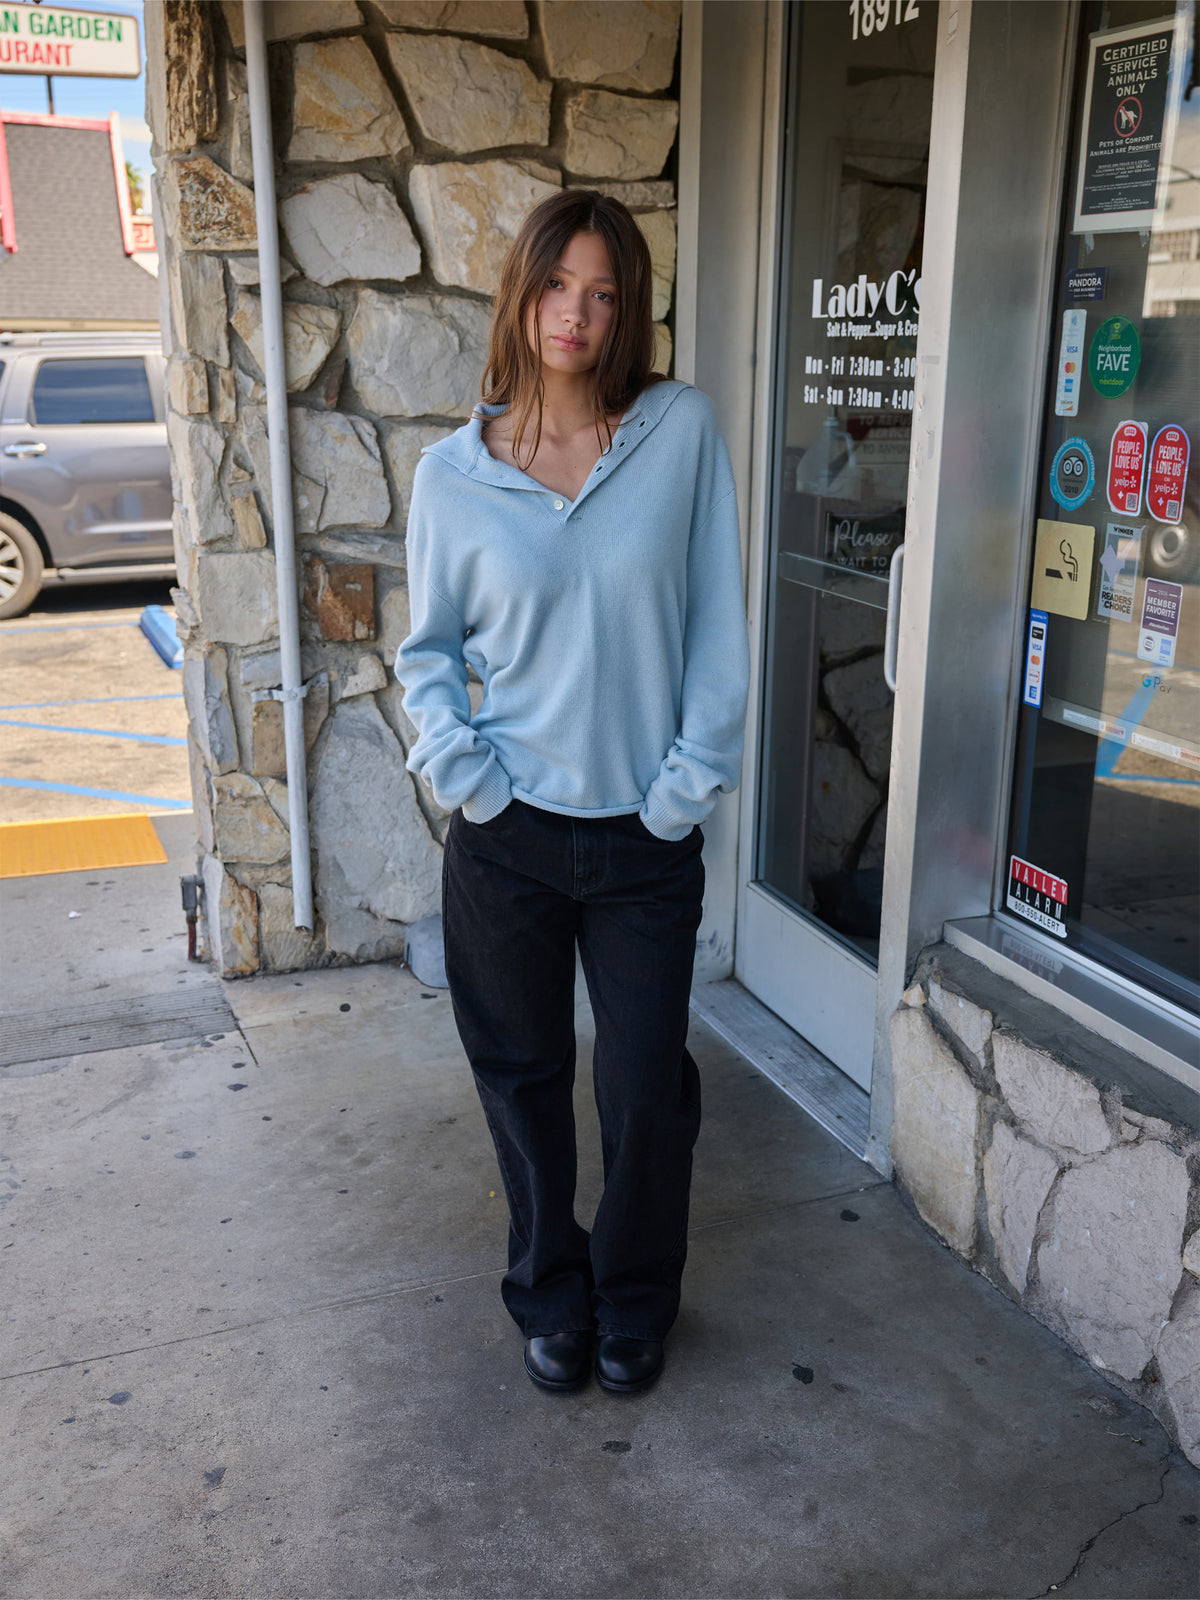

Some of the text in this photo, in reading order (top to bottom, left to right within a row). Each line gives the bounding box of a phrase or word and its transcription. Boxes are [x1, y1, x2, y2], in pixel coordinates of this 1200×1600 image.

[29, 12, 122, 42] GARDEN
[1103, 38, 1168, 62] CERTIFIED
[1110, 56, 1157, 74] SERVICE
[1107, 68, 1158, 87] ANIMALS
[1116, 83, 1146, 97] ONLY
[1125, 135, 1154, 144] COMFORT
[1089, 149, 1114, 157] ANIMALS
[1069, 277, 1102, 288] PANDORA
[827, 321, 840, 337] Salt
[841, 322, 847, 337] &
[897, 320, 903, 336] &
[1098, 345, 1132, 353] Neighborhood
[805, 356, 822, 374] Mon
[831, 356, 844, 375] Fri
[850, 356, 883, 376] 7:30am
[894, 357, 916, 377] 3:00
[1097, 354, 1131, 371] FAVE
[1099, 378, 1124, 386] nextdoor
[804, 385, 818, 404] Sat
[827, 386, 843, 405] Sun
[848, 387, 881, 408] 7:30am
[892, 389, 914, 410] 4:00
[1117, 440, 1140, 455] PEOPLE
[1158, 445, 1183, 461] PEOPLE
[1115, 455, 1139, 470] LOVE US
[1155, 460, 1182, 476] LOVE US
[1114, 477, 1129, 488] yelp
[1154, 484, 1170, 494] yelp
[833, 519, 893, 553] Please
[1113, 526, 1134, 536] WINNER
[837, 556, 887, 568] WAIT TO
[1101, 591, 1133, 606] READERS
[1147, 596, 1177, 611] MEMBER
[1104, 600, 1131, 614] CHOICE
[1146, 604, 1176, 619] FAVORITE
[1015, 862, 1067, 902] VALLEY
[1015, 882, 1062, 920] ALARM
[1015, 901, 1060, 931] 800-550-ALERT
